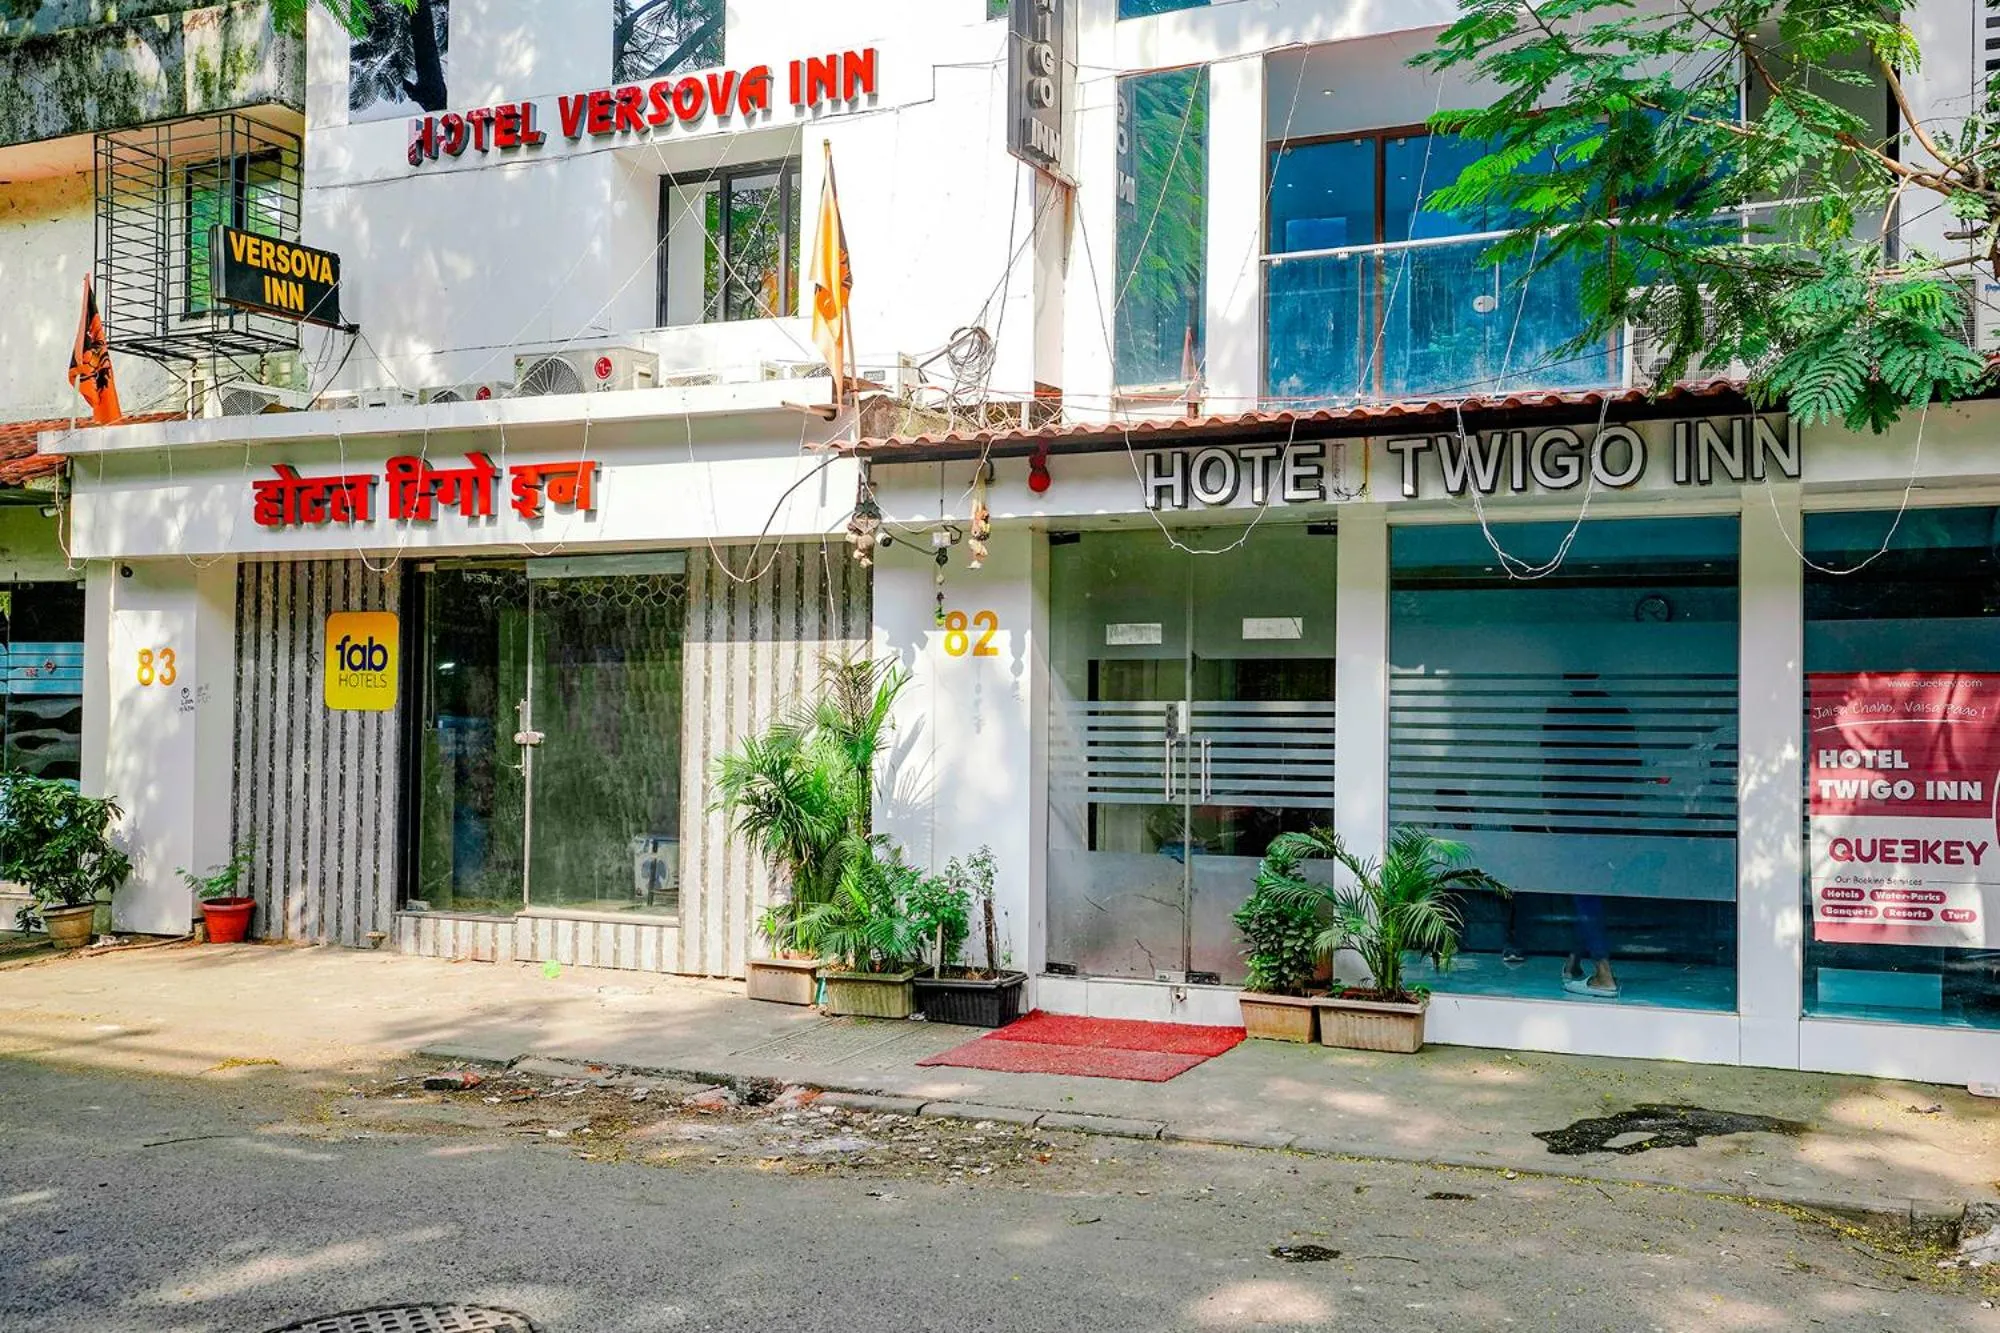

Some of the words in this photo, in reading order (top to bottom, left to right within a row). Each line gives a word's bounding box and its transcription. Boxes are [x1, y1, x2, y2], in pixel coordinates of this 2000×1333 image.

[408, 102, 546, 167] HOTEL
[558, 65, 773, 139] VERSOVA
[790, 48, 879, 108] INN
[1029, 117, 1061, 164] INN
[229, 231, 334, 286] VERSOVA
[264, 275, 305, 312] INN
[1145, 442, 1349, 509] HOTE
[1387, 425, 1646, 497] TWIGO
[1673, 416, 1801, 484] INN
[252, 464, 379, 526] होटल
[944, 610, 999, 657] 82
[137, 647, 176, 686] 83
[335, 635, 388, 672] fab
[338, 673, 387, 688] HOTELS
[1813, 706, 1848, 719] Jaisa
[1904, 702, 1941, 713] Vaisa
[1819, 749, 1909, 769] HOTEL
[1818, 779, 1915, 800] TWIGO
[1926, 780, 1982, 801] INN
[1827, 890, 1860, 899] Hotels
[1835, 876, 1851, 884] Our
[1826, 907, 1874, 918] Banquets
[1888, 909, 1928, 919] Resorts
[1947, 911, 1971, 921] Turf
